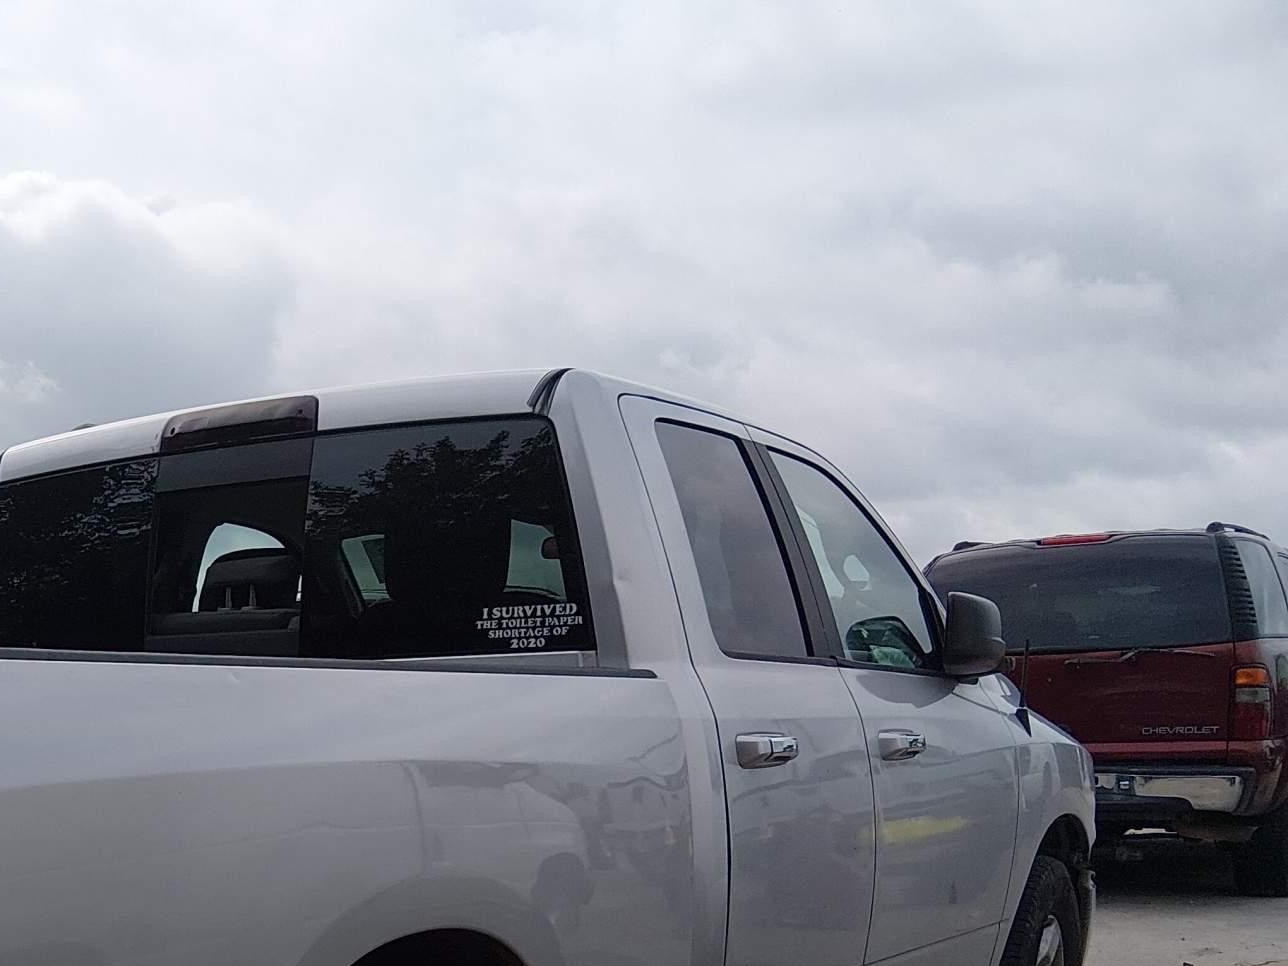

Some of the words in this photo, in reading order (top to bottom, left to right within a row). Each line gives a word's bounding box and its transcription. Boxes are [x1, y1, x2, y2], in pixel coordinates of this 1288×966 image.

[482, 607, 489, 619] I
[492, 603, 578, 619] SURVIVED
[475, 620, 499, 629] THE
[501, 617, 543, 628] TOILET
[545, 616, 584, 626] PAPER
[488, 627, 551, 639] SHORTAGE
[552, 626, 570, 636] OF
[510, 638, 546, 649] 2020
[1142, 725, 1220, 735] CHEVROLET
